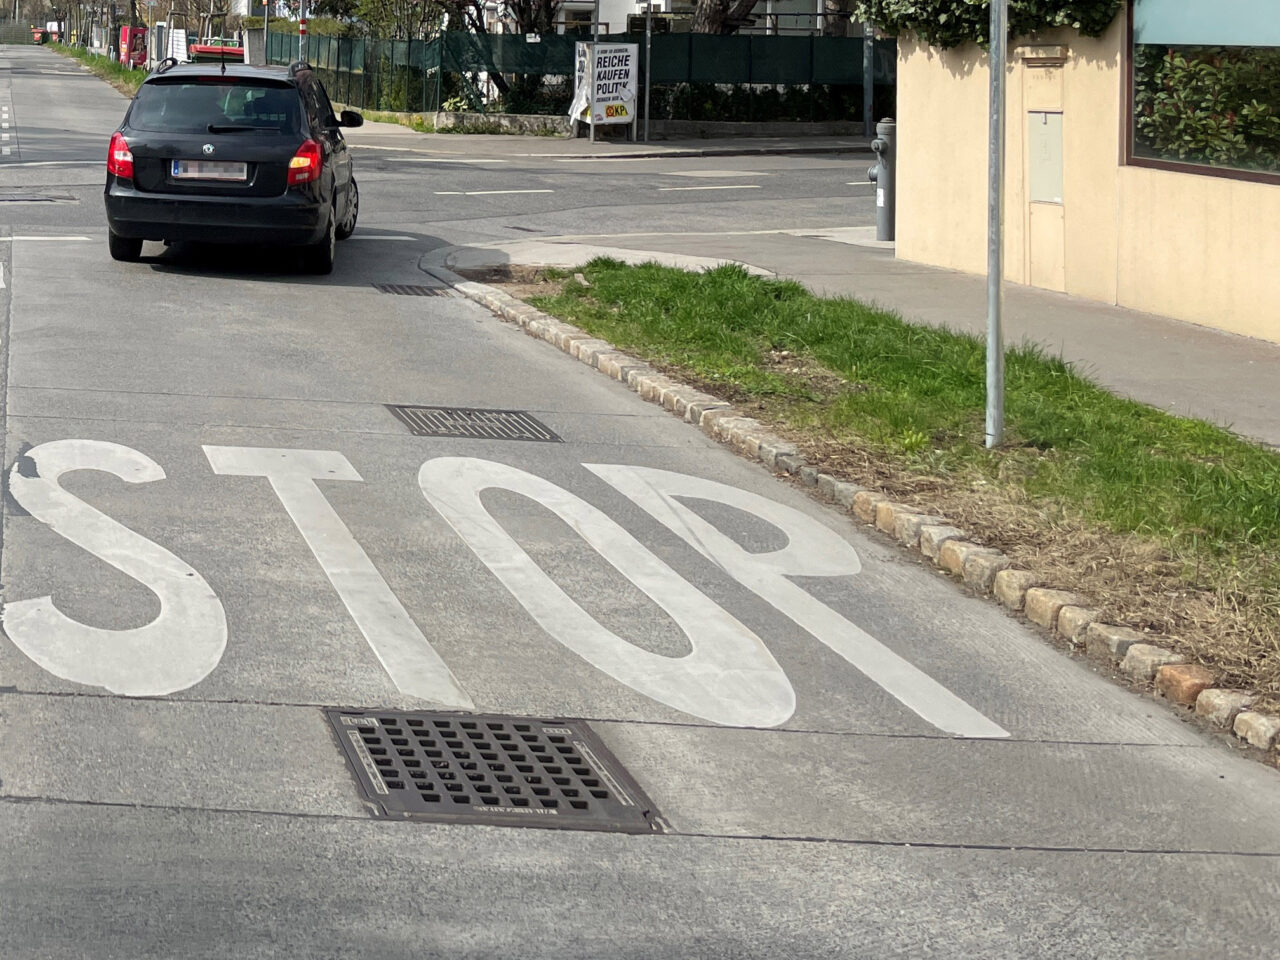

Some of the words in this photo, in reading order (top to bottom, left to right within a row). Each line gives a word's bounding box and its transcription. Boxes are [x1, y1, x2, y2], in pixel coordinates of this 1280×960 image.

[596, 55, 630, 68] REICHE
[596, 68, 630, 81] KAUFEN
[2, 438, 1012, 740] STOP
